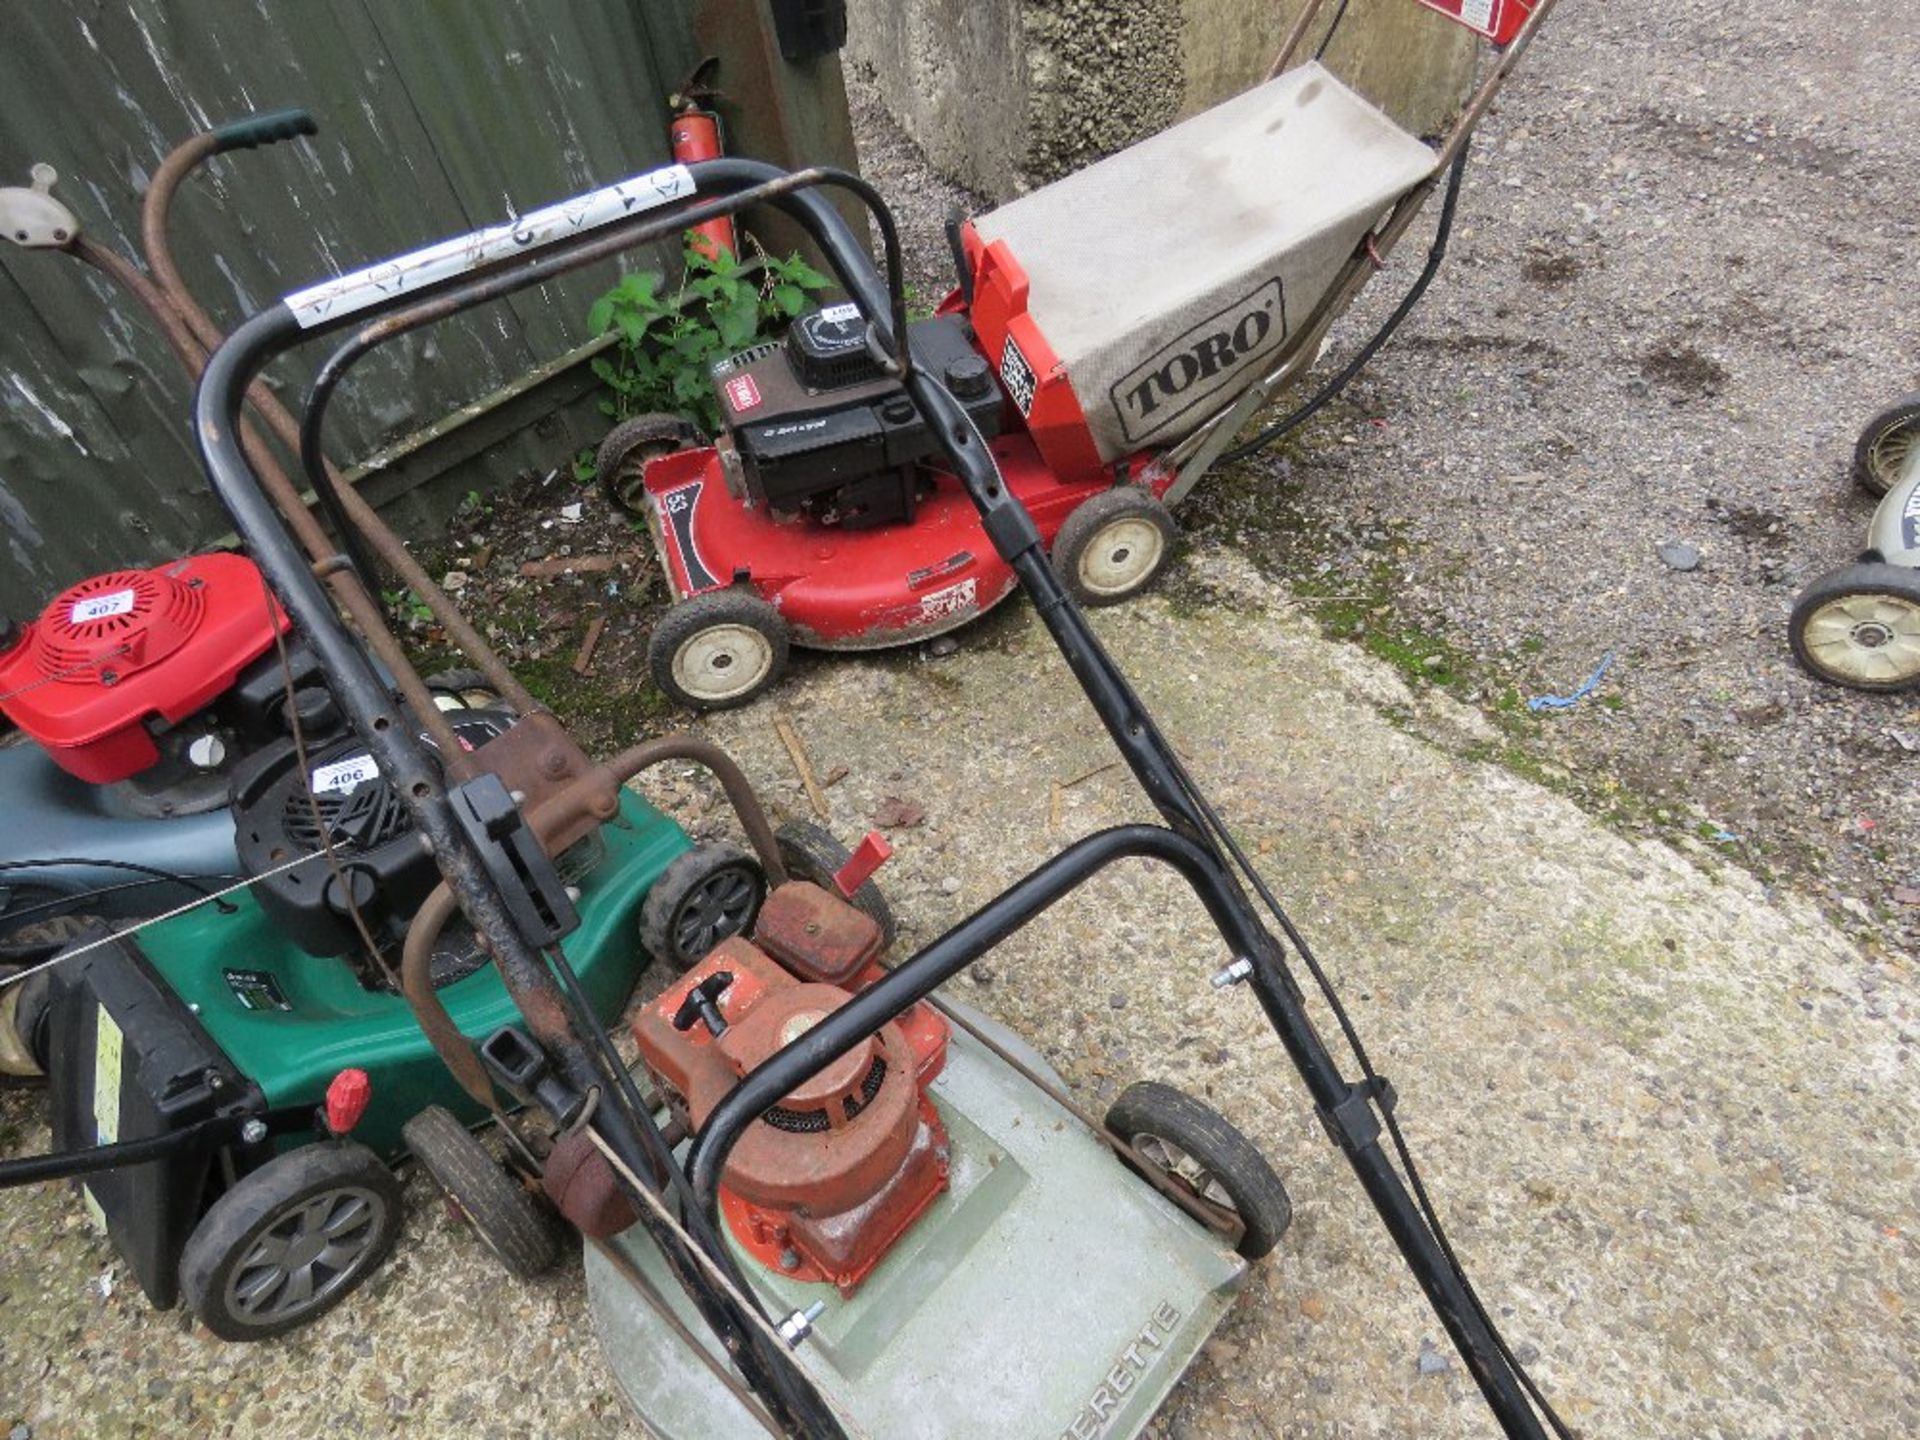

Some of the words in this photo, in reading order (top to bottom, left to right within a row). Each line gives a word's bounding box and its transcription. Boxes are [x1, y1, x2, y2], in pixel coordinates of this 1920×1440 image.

[1126, 310, 1270, 420] TORO
[667, 493, 689, 514] 53
[87, 602, 120, 616] 407
[328, 769, 364, 786] 406
[1060, 1300, 1182, 1440] ERETTE
